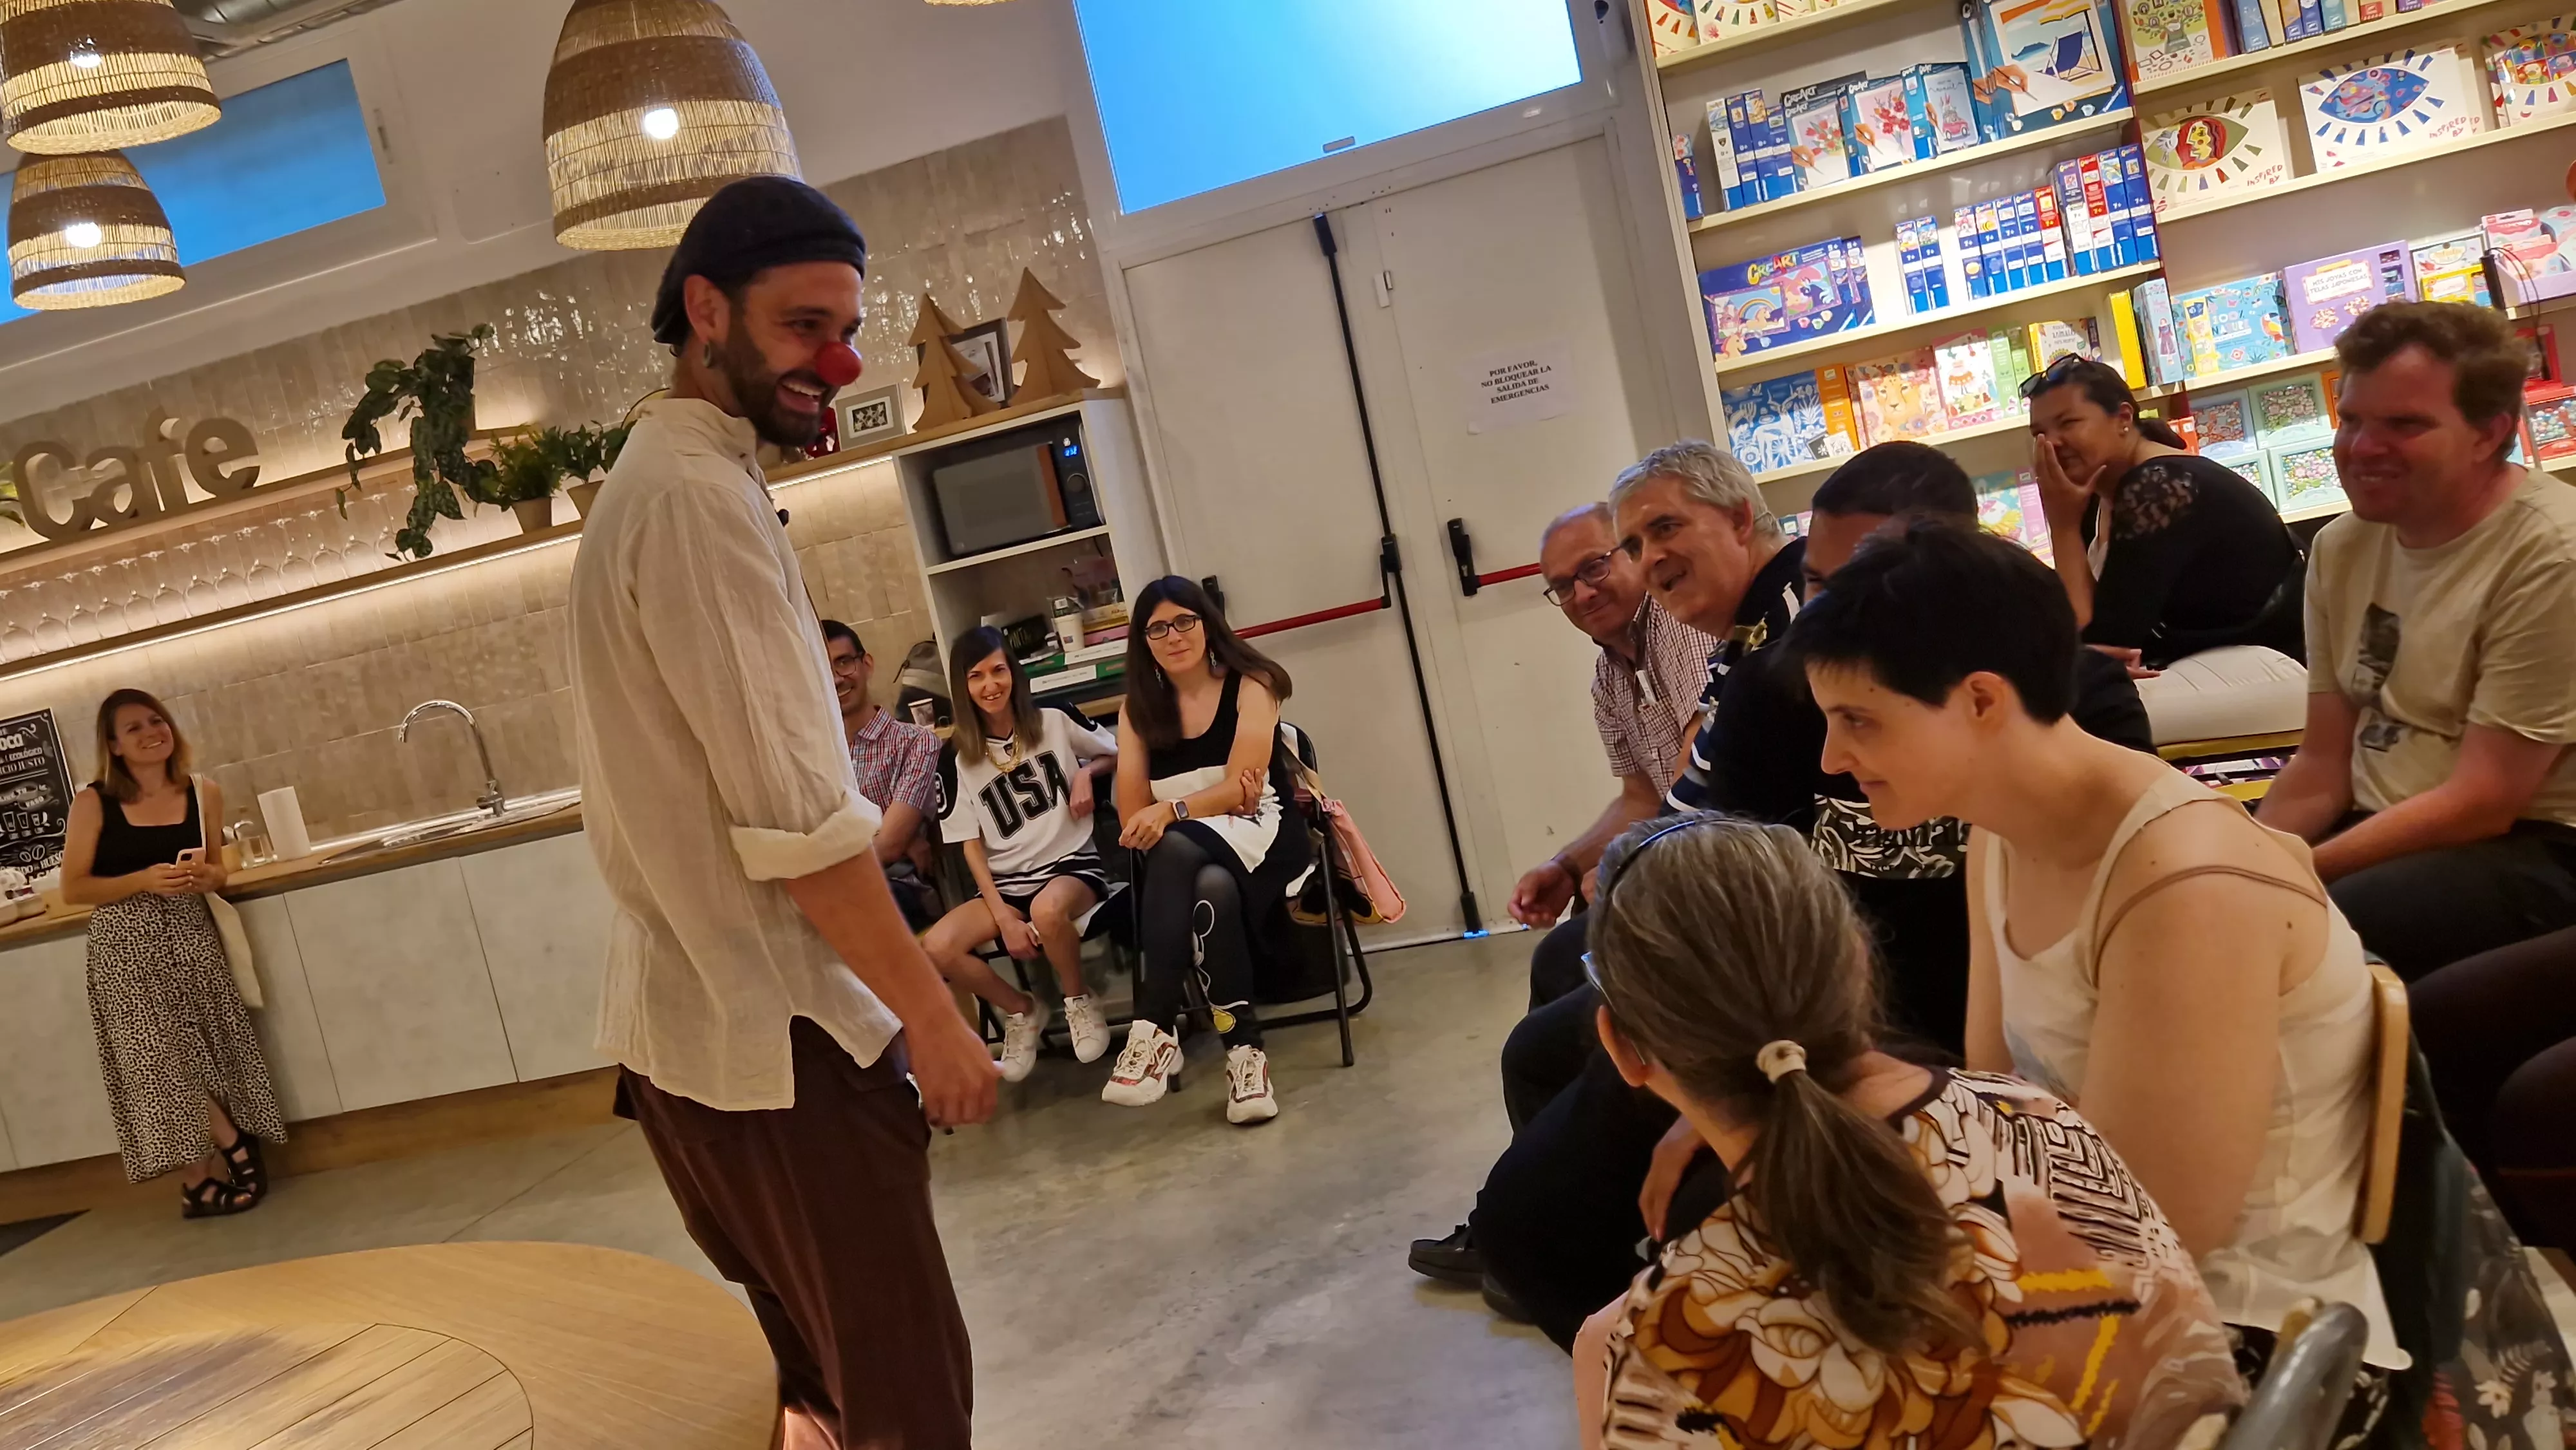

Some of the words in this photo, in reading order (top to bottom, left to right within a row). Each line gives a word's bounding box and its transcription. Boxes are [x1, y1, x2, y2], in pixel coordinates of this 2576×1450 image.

[2429, 116, 2467, 138] INSPIRED
[2452, 127, 2464, 137] BY
[2247, 164, 2283, 186] INSPIRED
[2269, 174, 2280, 185] BY
[2309, 284, 2329, 294] TELAS
[2331, 274, 2368, 288] JAPONESAS
[2325, 273, 2347, 282] JOYAS
[2348, 268, 2363, 276] CON
[1490, 368, 1507, 377] POR
[1494, 369, 1539, 385] BLOQUEAR
[1540, 364, 1552, 373] LA
[1491, 384, 1550, 404] EMERGENCIAS
[1497, 381, 1527, 393] SALIDA
[1528, 377, 1539, 386] DE
[978, 749, 1071, 840] USA
